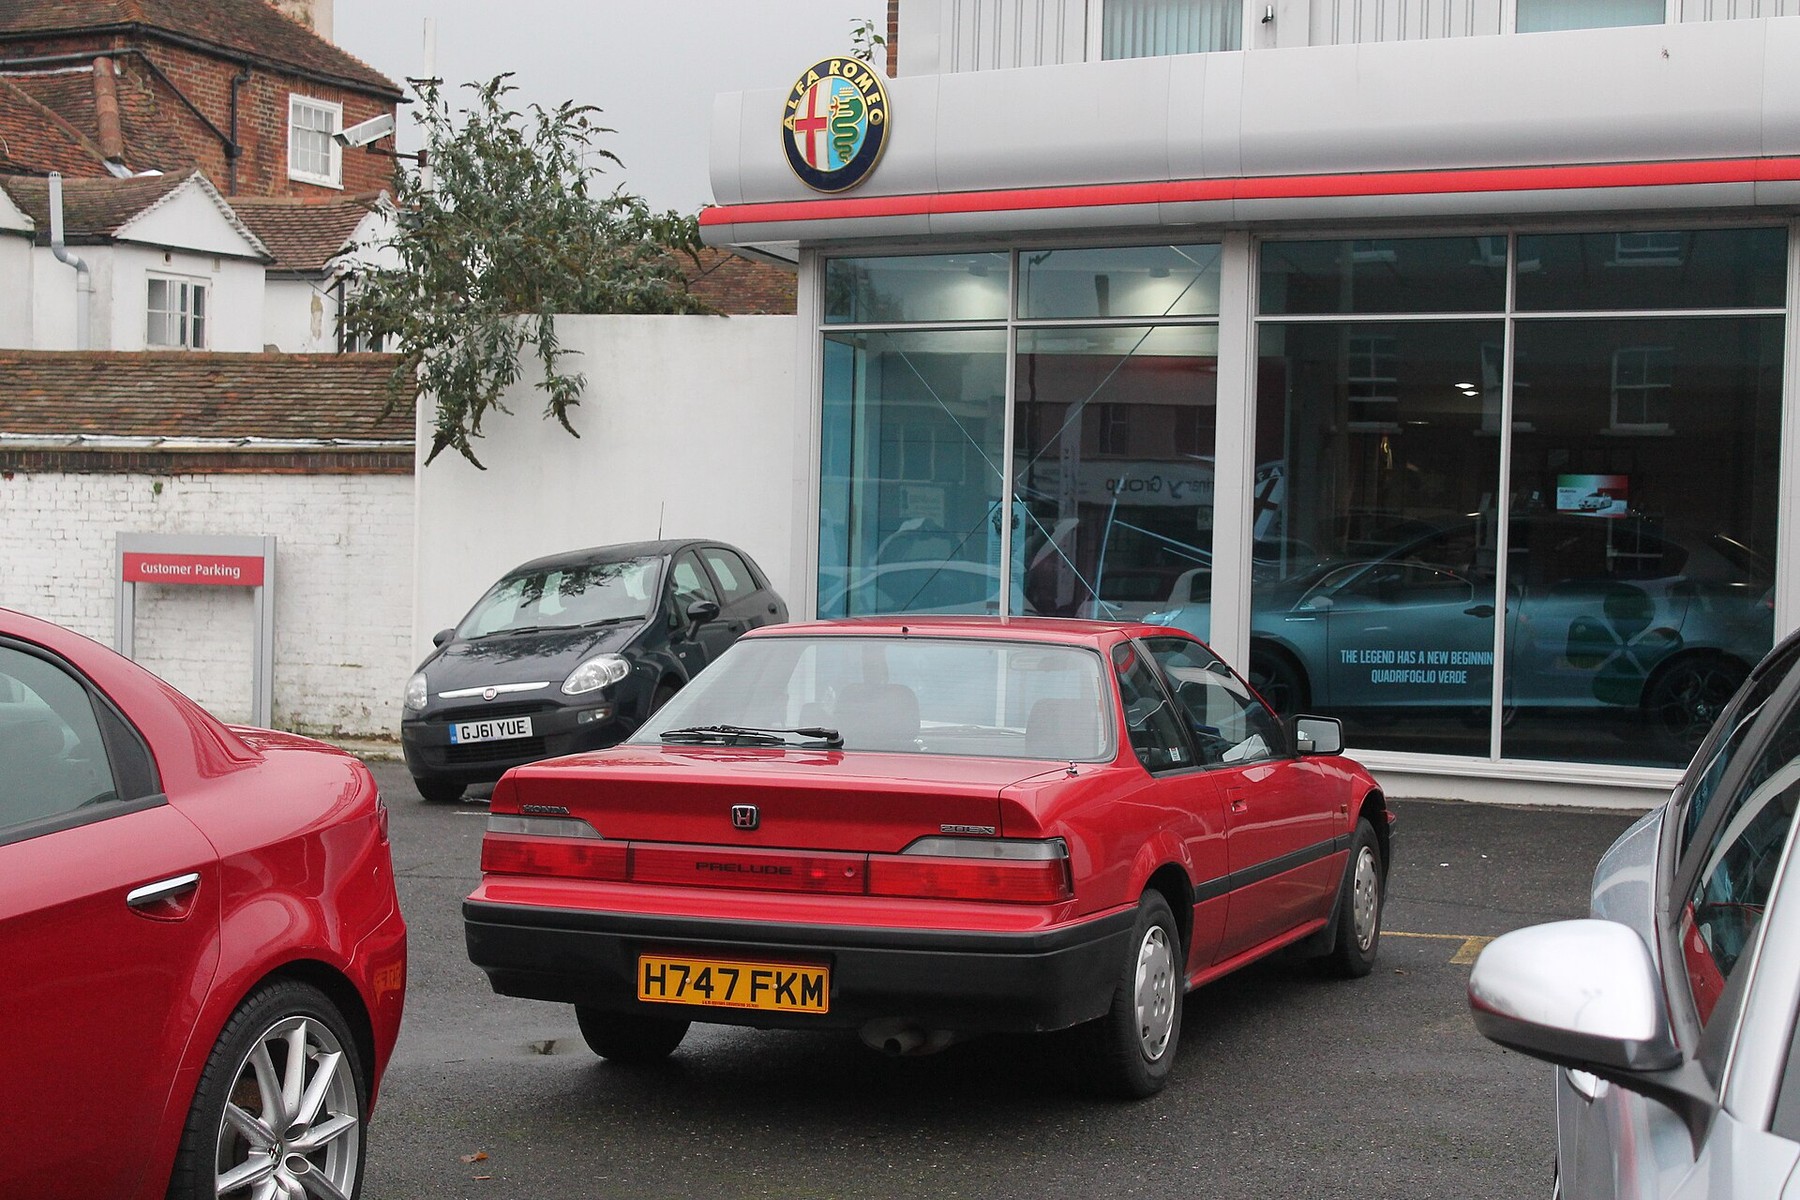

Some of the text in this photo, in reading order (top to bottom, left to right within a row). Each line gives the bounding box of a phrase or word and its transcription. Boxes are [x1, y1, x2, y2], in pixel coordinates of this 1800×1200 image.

[784, 59, 884, 131] ALFA ROMEO
[141, 562, 241, 579] Customer Parking
[1341, 650, 1494, 665] THE LEGEND HAS A NEW BEGINNIN
[1371, 669, 1467, 684] QUADRIFOGLIO VERDE
[461, 720, 527, 740] GJ61 YUE
[523, 804, 570, 814] HONDA
[695, 861, 793, 875] PRELUDE
[644, 963, 823, 1008] H747 FKM
